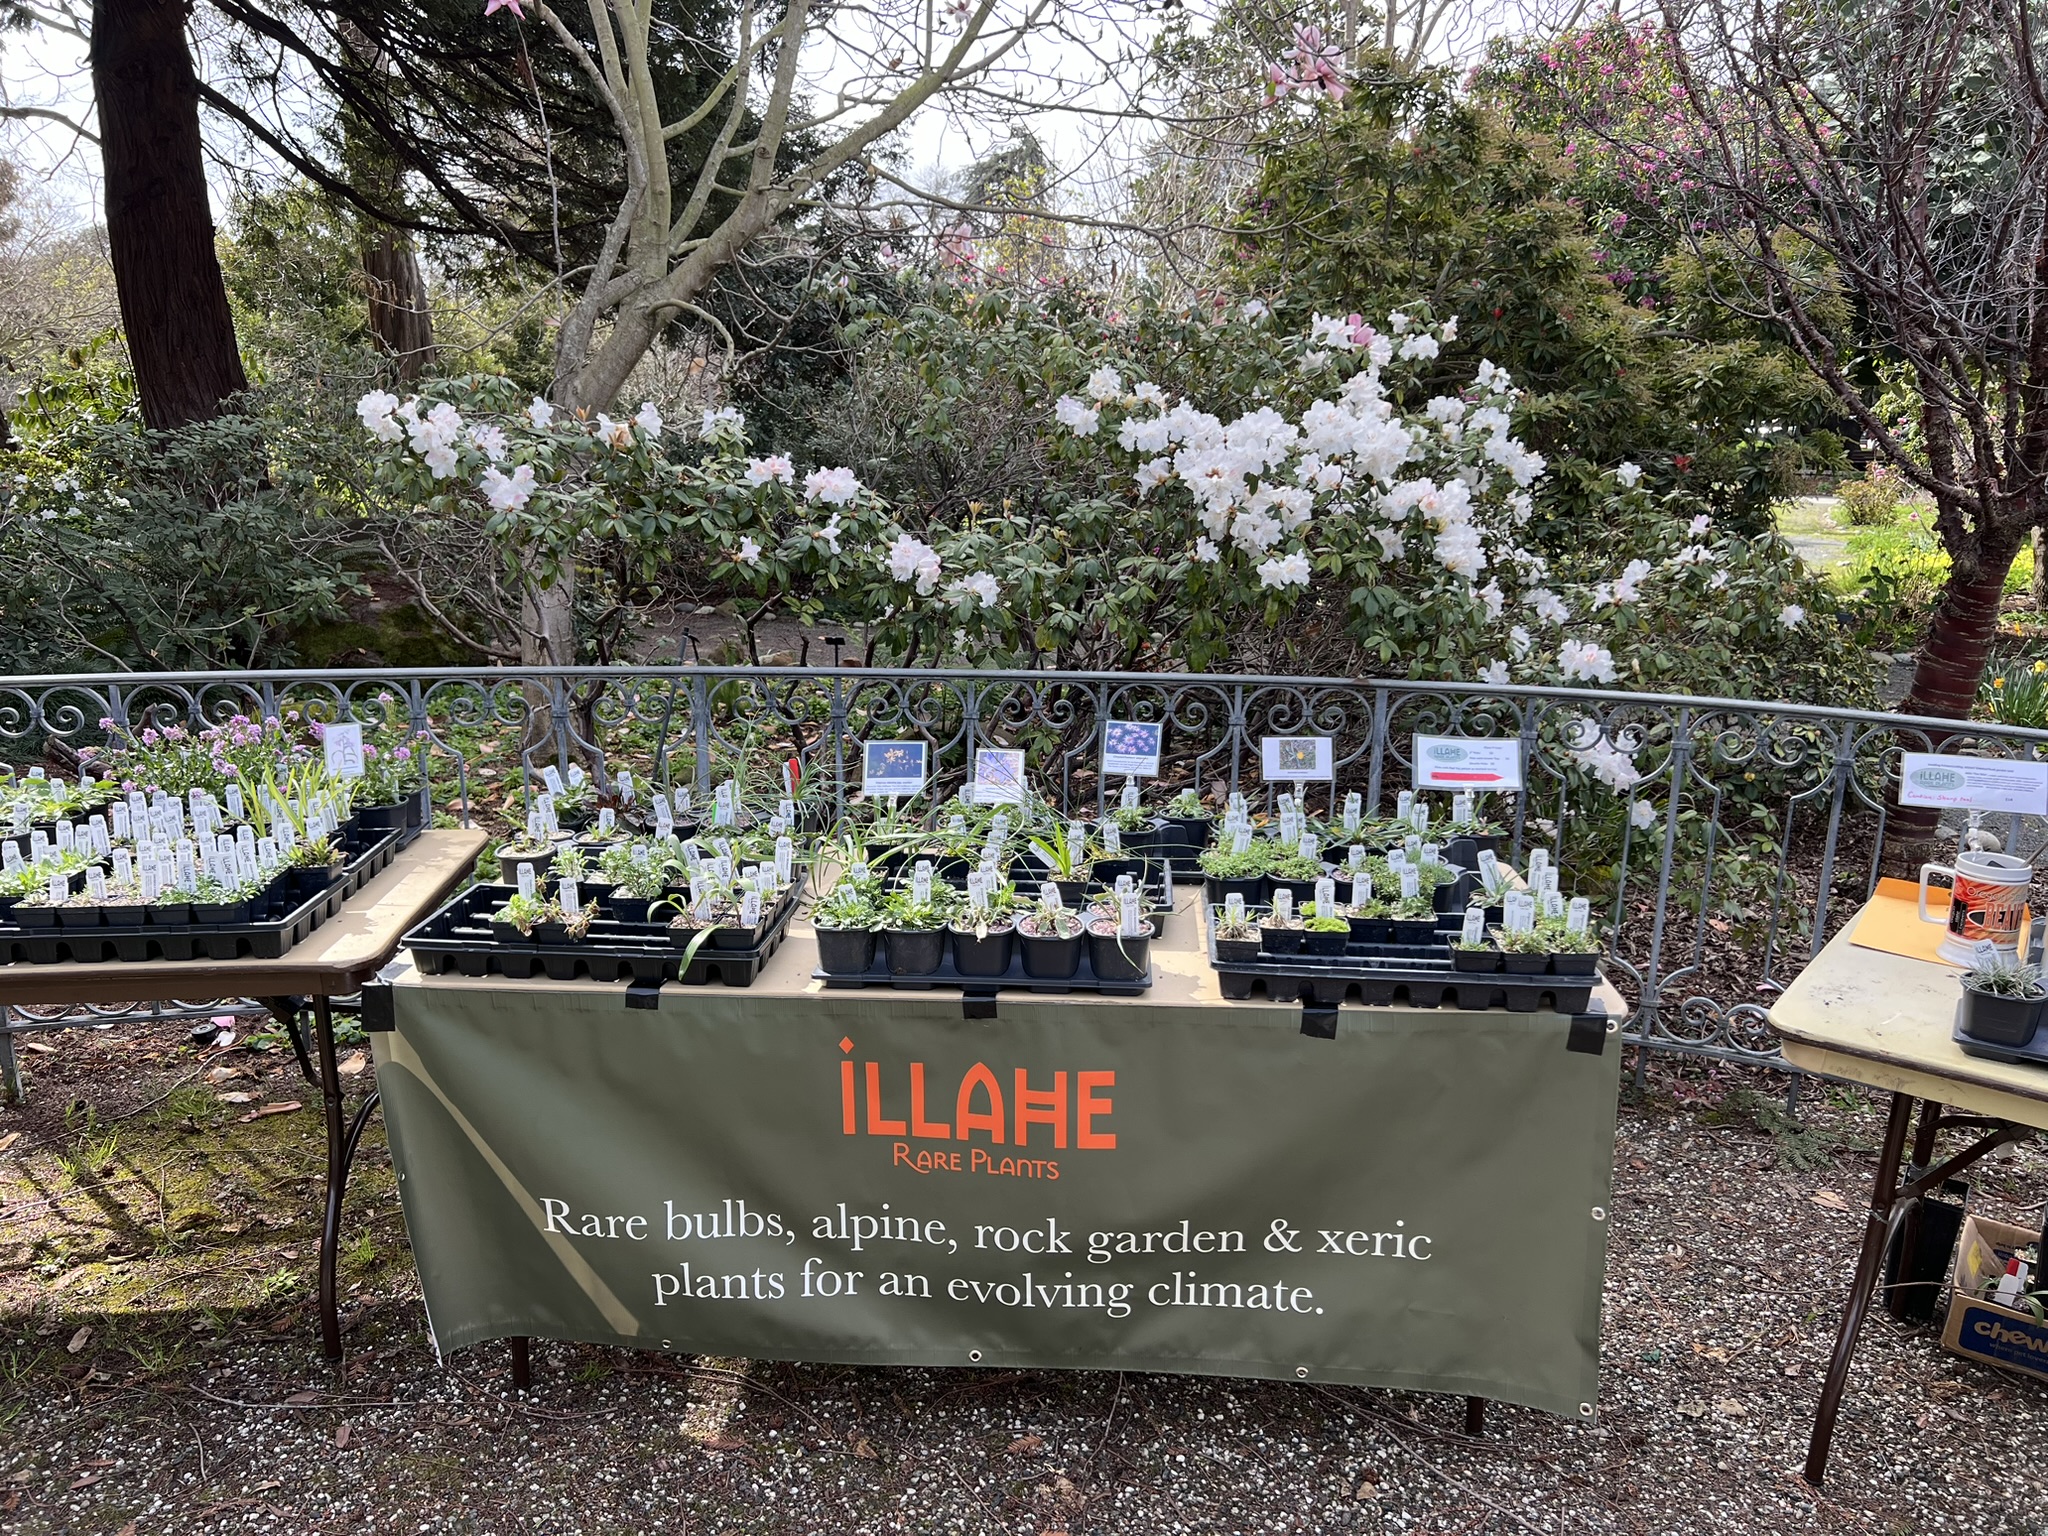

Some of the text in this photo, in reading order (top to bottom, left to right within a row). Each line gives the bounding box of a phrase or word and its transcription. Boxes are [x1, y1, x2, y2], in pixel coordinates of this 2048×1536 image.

[540, 1198, 1432, 1263] Rare bulbs, alpine, rock garden & xeric
[652, 1258, 1324, 1317] plants for an evolving climate.
